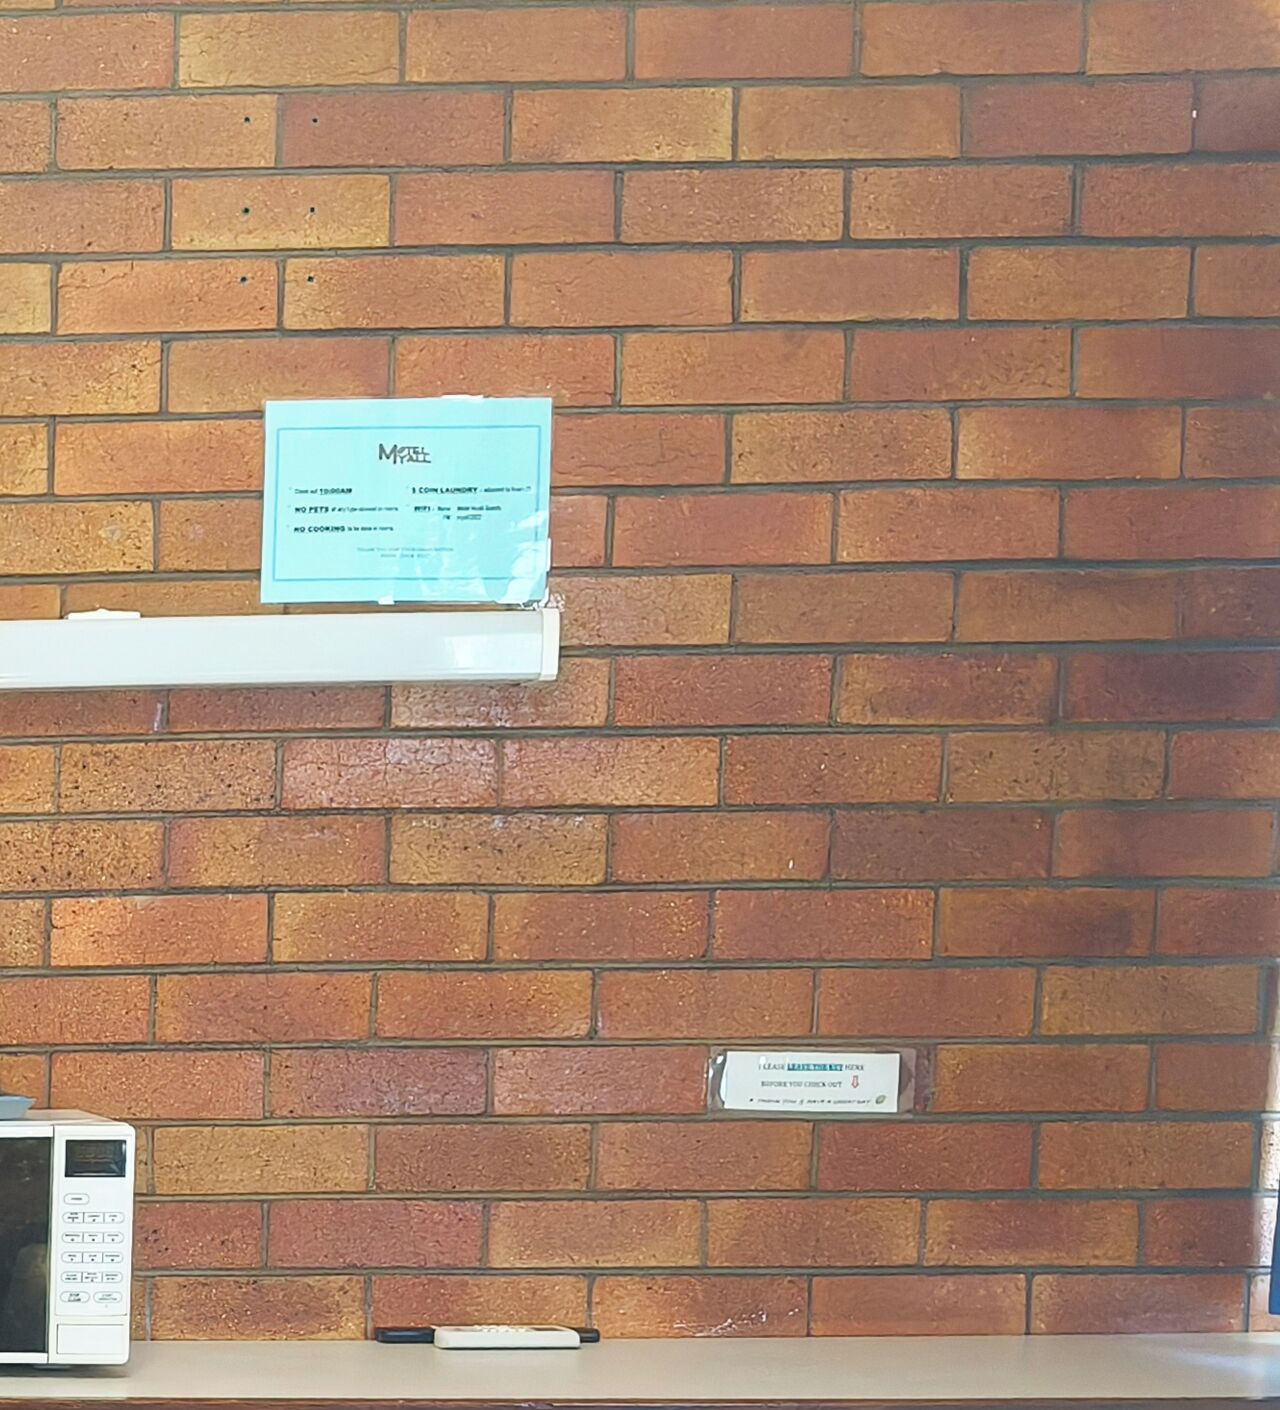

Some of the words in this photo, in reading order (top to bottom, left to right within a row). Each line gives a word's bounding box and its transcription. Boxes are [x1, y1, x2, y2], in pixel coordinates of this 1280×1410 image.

[440, 486, 478, 494] LAUNDRY
[294, 526, 306, 534] NO
[308, 526, 346, 534] COOKING
